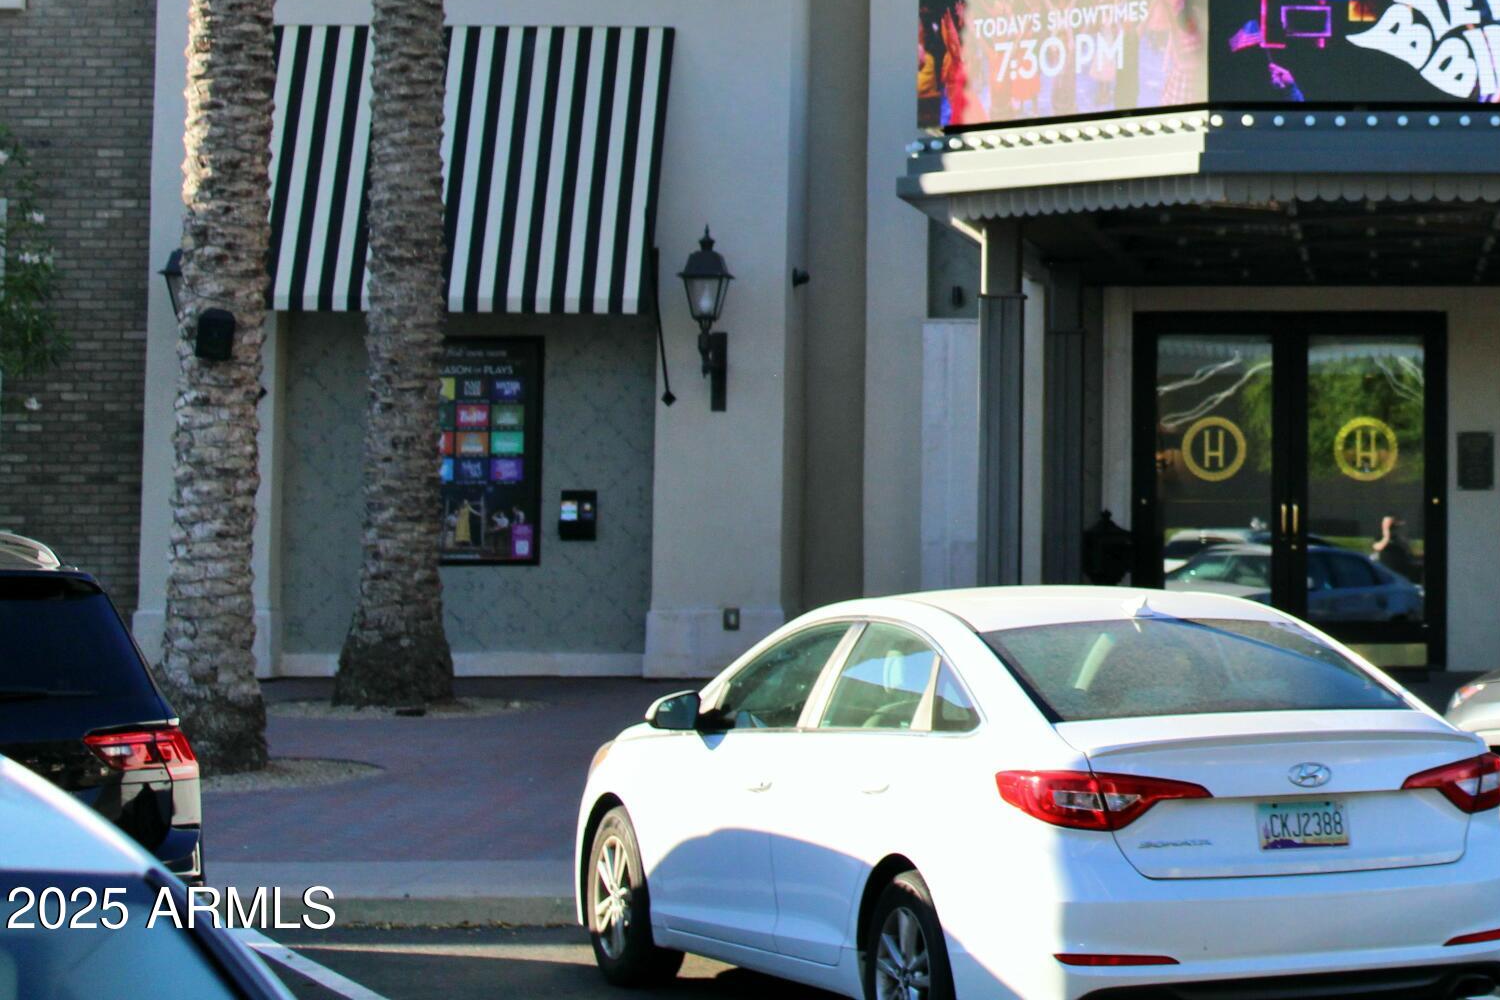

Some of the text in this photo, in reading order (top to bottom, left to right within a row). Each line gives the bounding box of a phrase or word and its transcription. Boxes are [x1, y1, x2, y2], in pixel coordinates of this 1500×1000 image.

[974, 0, 1149, 39] TODAY'S SHOWTIMES
[994, 31, 1124, 82] 7:30 PM
[439, 365, 472, 375] ASON
[484, 365, 513, 375] PLAYS
[1204, 430, 1224, 468] H
[1356, 430, 1376, 468] H
[1269, 811, 1344, 838] CKJ2388
